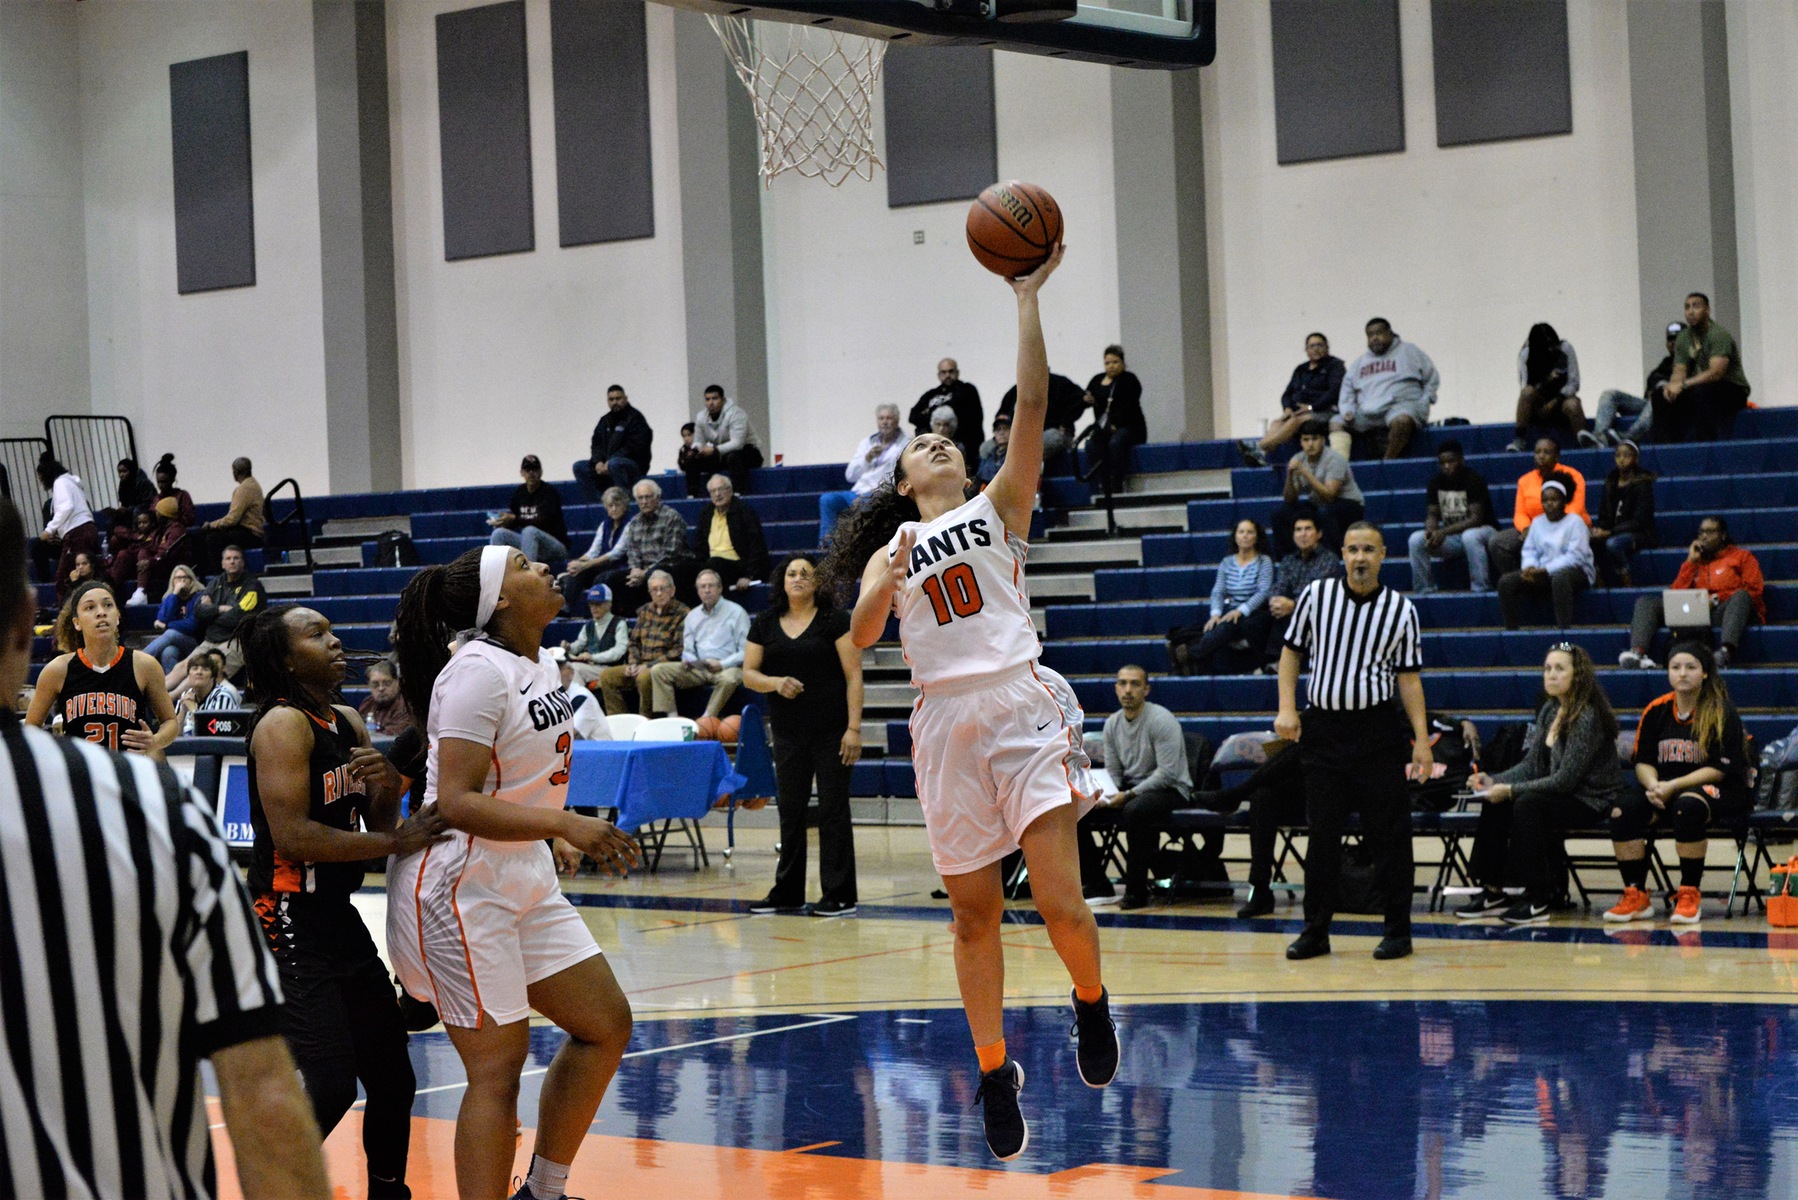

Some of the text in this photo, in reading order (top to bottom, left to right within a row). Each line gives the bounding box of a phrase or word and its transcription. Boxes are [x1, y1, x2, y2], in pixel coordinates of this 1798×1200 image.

[1359, 360, 1397, 378] GONZAGA
[907, 519, 991, 578] ANTS
[921, 562, 984, 626] 10
[66, 692, 137, 723] RIVERSIDE
[528, 686, 574, 732] GIAN
[84, 722, 119, 752] 21
[215, 720, 232, 732] POSS
